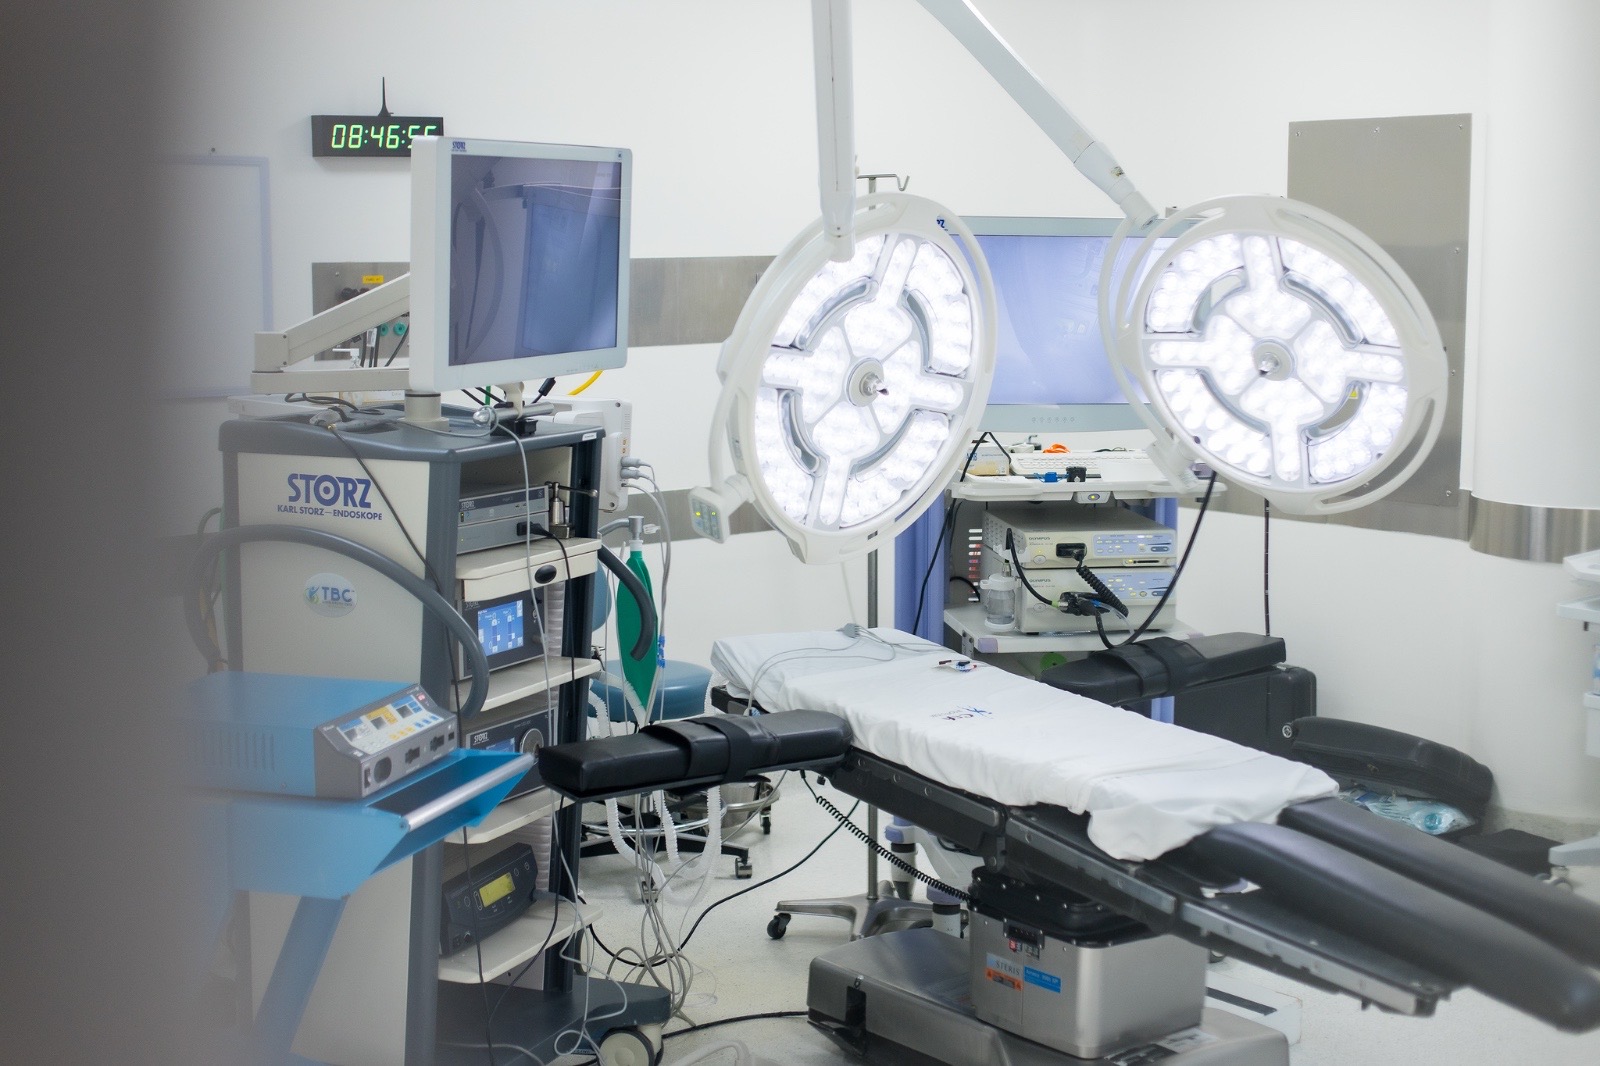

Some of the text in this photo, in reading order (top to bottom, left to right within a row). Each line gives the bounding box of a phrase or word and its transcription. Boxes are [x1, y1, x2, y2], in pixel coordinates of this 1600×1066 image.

[287, 473, 372, 509] STORZ
[277, 504, 298, 514] KARL
[321, 586, 353, 603] TBC
[995, 960, 1020, 976] STERIS
